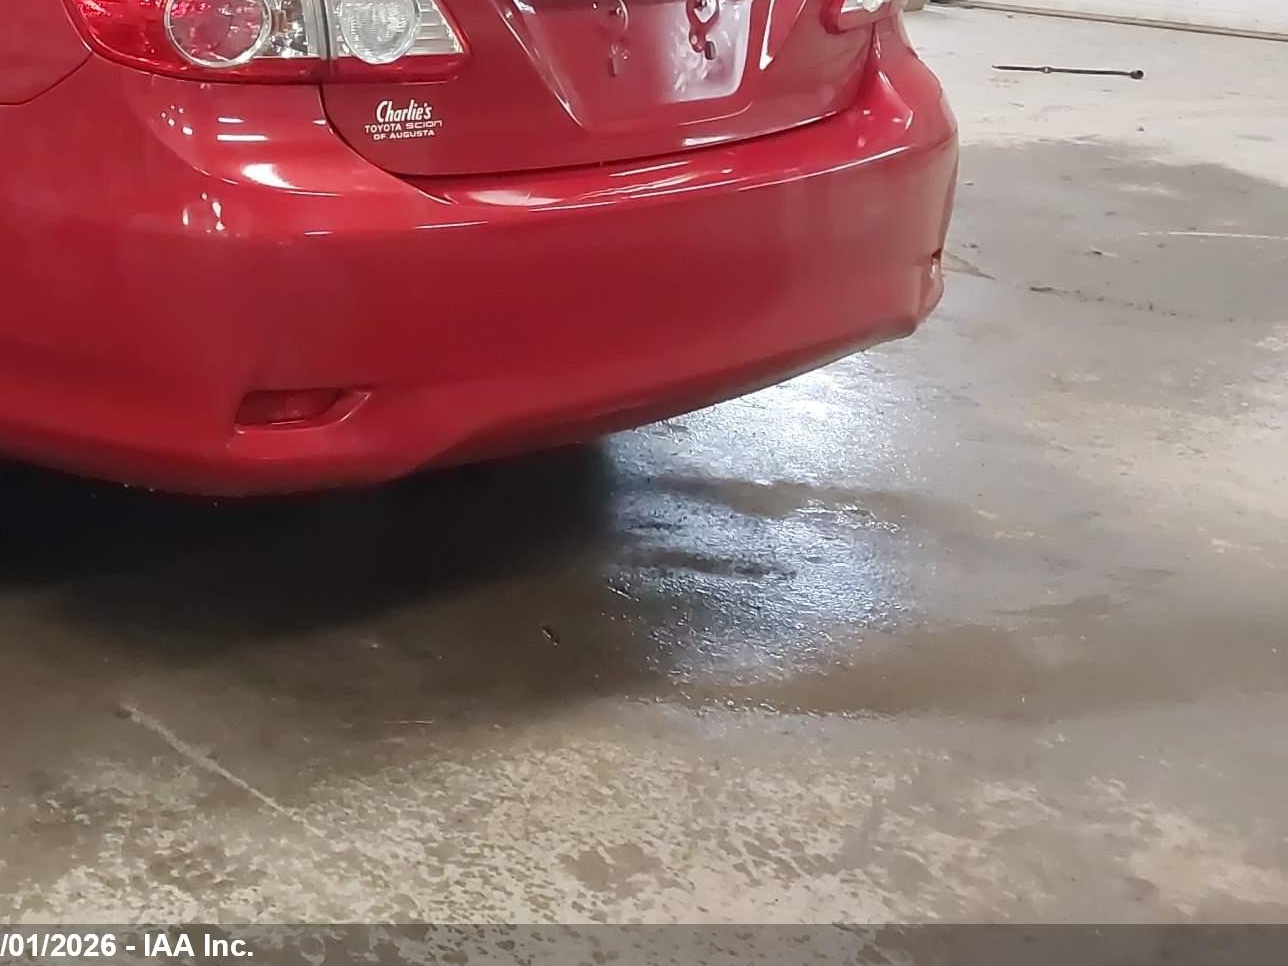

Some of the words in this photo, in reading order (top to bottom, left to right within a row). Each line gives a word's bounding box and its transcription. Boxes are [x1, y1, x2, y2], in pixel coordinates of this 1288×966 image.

[376, 99, 432, 123] Charlie's
[364, 123, 402, 134] TOYOTA
[373, 133, 387, 141] OF
[389, 129, 435, 140] AUGUSTA
